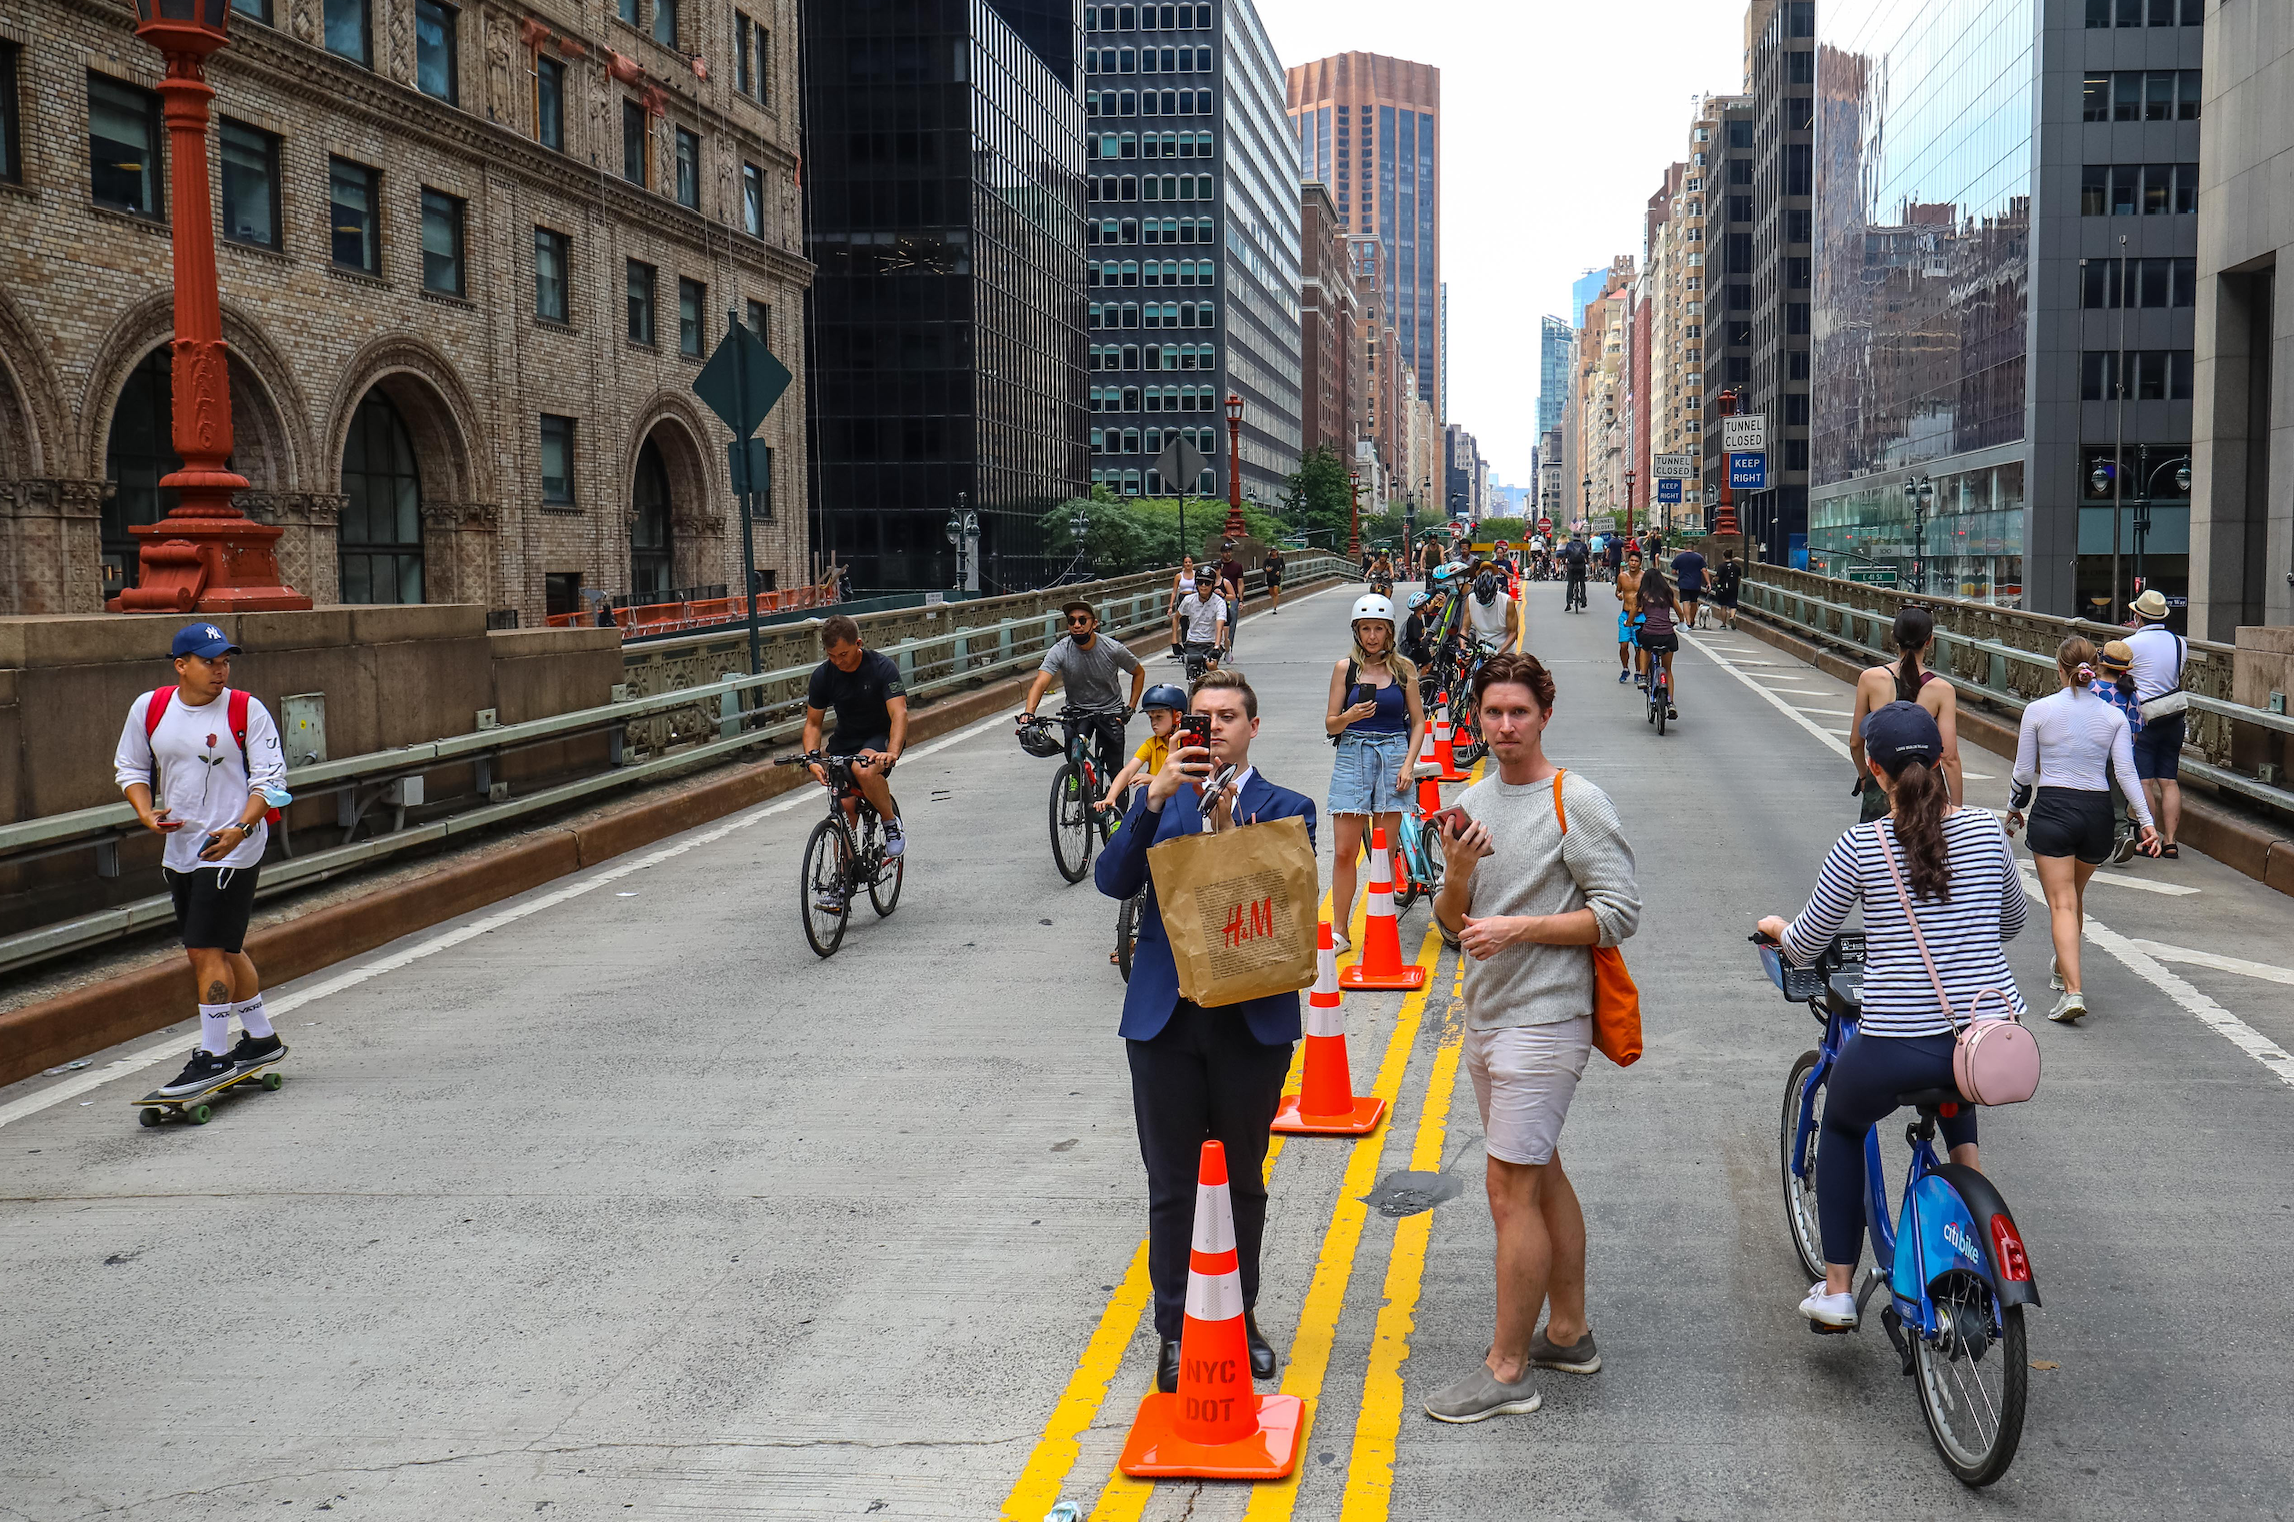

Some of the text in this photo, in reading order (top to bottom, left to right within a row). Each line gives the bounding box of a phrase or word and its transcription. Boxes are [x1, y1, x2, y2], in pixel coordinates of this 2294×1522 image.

[1725, 420, 1762, 432] TUNNEL
[1725, 434, 1762, 447] CLOSED
[1656, 456, 1690, 465] TUNNEL
[1735, 459, 1760, 468] KEEP
[1656, 467, 1690, 475] CLOSED
[1733, 473, 1761, 483] RIGHT
[1221, 896, 1273, 949] H&M
[1186, 1358, 1236, 1384] NYC
[1186, 1397, 1235, 1423] DOT
